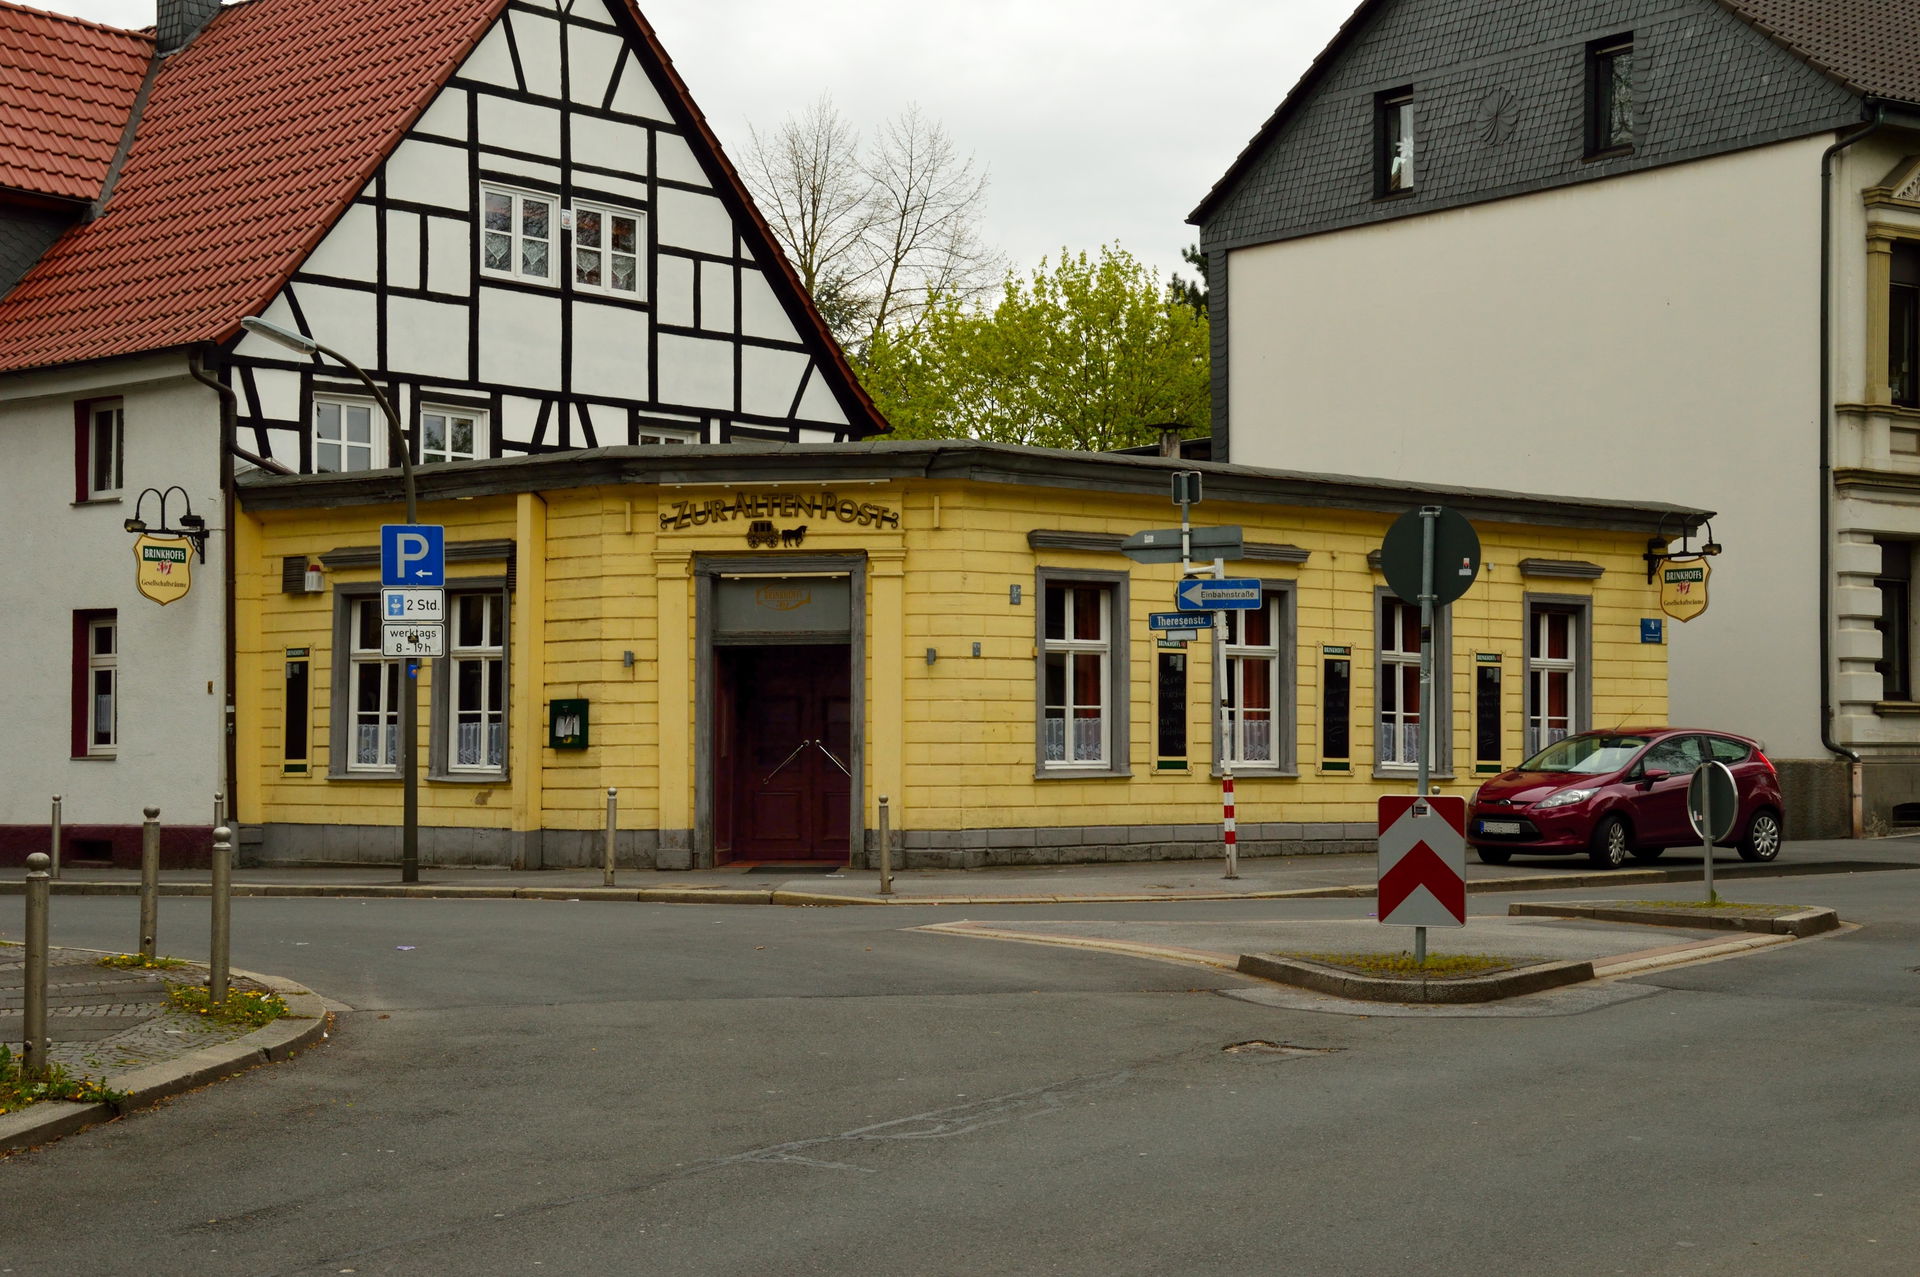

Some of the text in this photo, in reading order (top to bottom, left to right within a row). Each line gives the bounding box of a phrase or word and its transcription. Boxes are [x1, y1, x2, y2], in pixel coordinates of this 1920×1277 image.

[672, 491, 890, 530] ZUR ALTEN POST
[396, 533, 430, 579] P
[1200, 590, 1255, 599] Einbahnstraße
[406, 599, 440, 611] 2 Std.
[1157, 615, 1206, 627] Theresenstr.
[390, 628, 437, 640] werktags
[395, 642, 403, 653] 8
